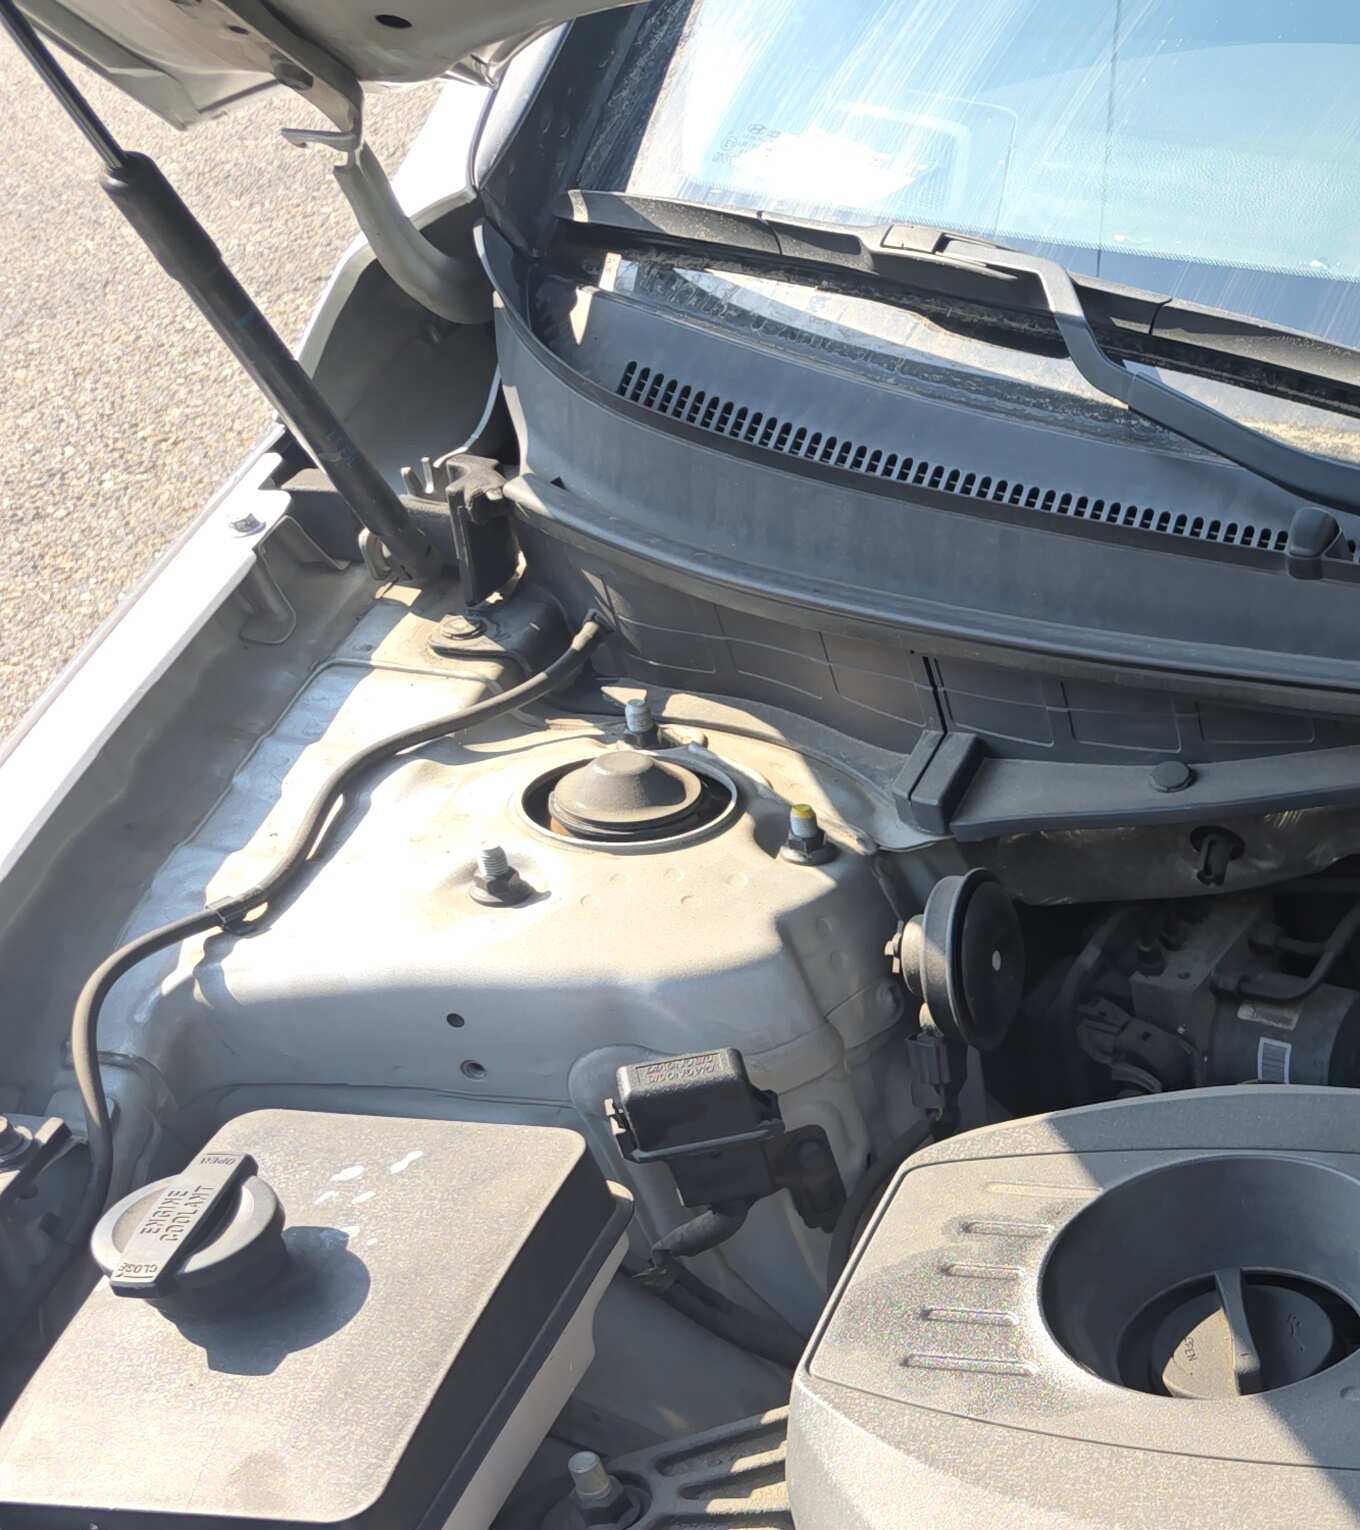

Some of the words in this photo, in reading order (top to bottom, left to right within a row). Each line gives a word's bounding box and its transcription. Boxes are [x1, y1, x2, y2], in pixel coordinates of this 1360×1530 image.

[140, 1189, 189, 1235] ENGINE
[159, 1185, 217, 1242] COOLANT
[117, 1261, 159, 1273] CLOSE
